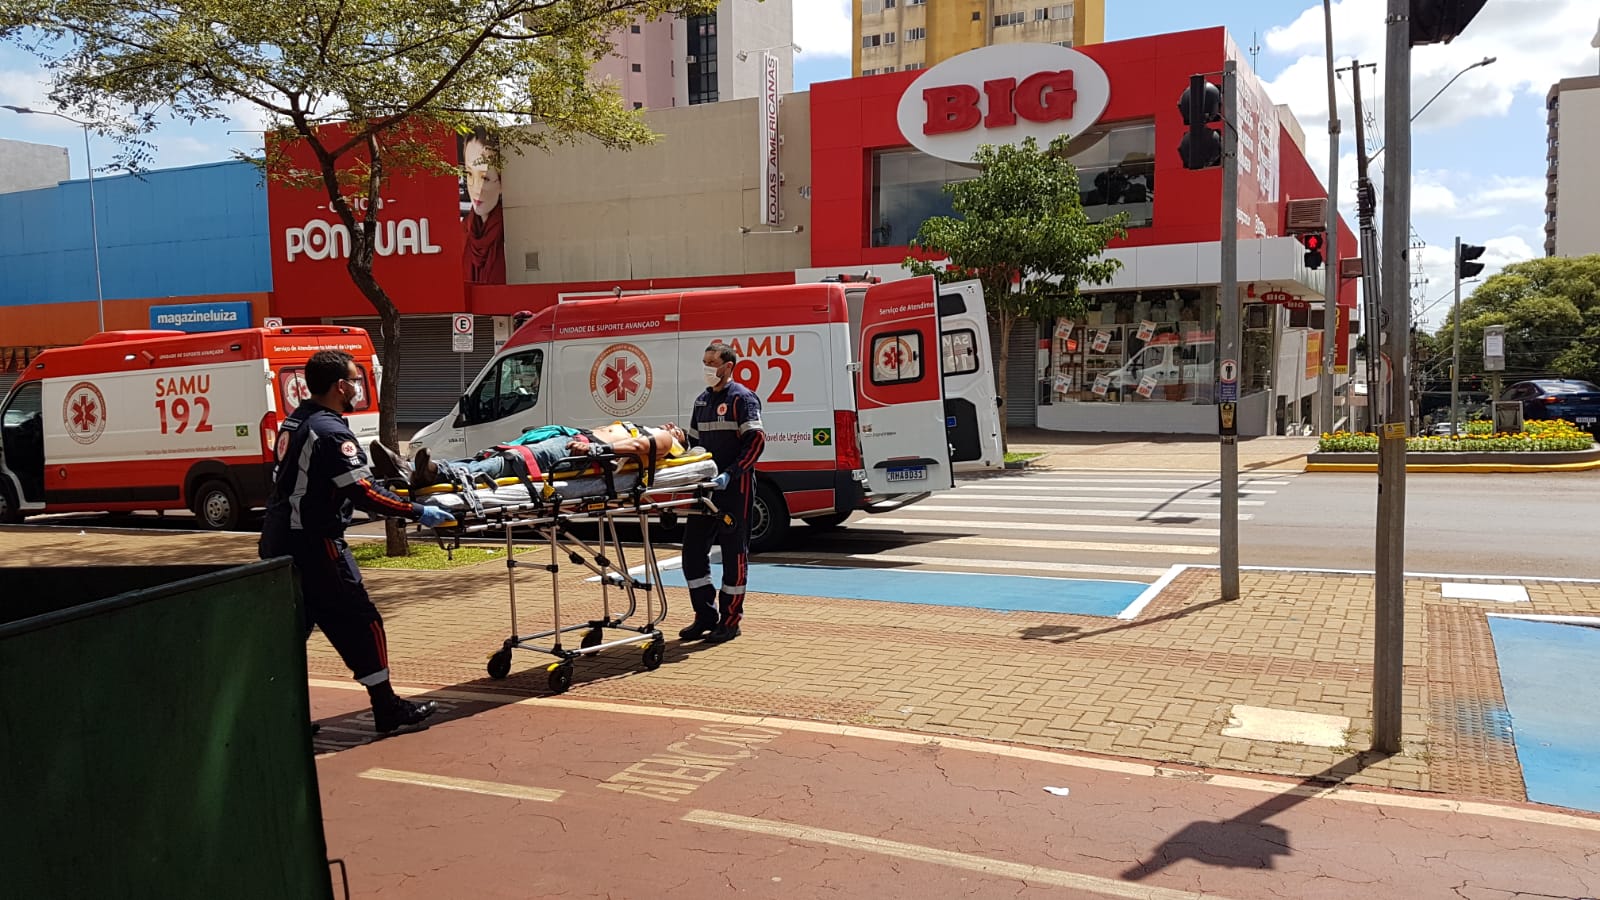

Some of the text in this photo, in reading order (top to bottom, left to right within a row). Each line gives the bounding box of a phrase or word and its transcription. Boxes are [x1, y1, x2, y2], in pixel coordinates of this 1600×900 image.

[922, 69, 1077, 136] BIG
[768, 57, 777, 224] LOJAS AMERICANAS
[285, 218, 442, 262] PONUAL
[157, 309, 237, 326] magazineluiza
[879, 306, 899, 315] Serviço
[899, 305, 907, 313] de
[460, 319, 467, 330] E
[560, 325, 586, 335] UNIDADE
[596, 322, 624, 331] SUPORTE
[625, 320, 660, 329] AVANÇADO
[155, 374, 210, 397] SAMU
[732, 358, 795, 403] 92
[155, 396, 213, 435] 192
[779, 432, 786, 442] de
[787, 431, 811, 444] Urgência
